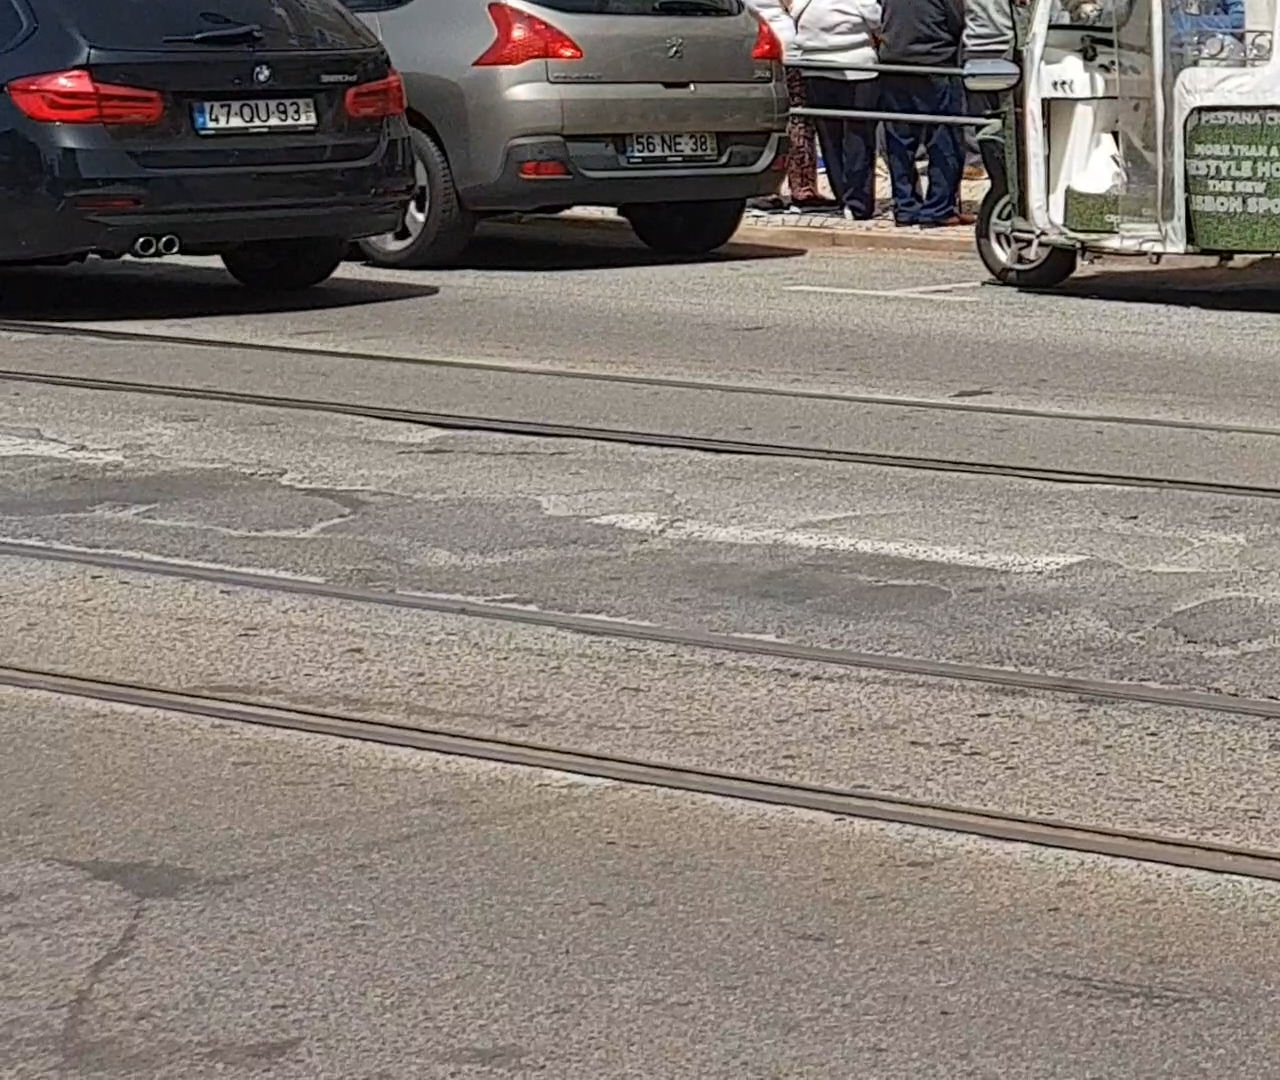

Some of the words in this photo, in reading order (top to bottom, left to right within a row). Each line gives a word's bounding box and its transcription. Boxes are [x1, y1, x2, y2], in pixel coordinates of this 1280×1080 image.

[208, 101, 301, 125] 47-QU-93
[1201, 112, 1261, 126] PESTANA
[635, 135, 709, 154] 56-NE-38
[1269, 145, 1279, 158] A
[1186, 159, 1254, 178] ESTYLE
[1207, 179, 1234, 193] THE
[1235, 180, 1267, 194] NEW
[1191, 195, 1243, 213] ISBON
